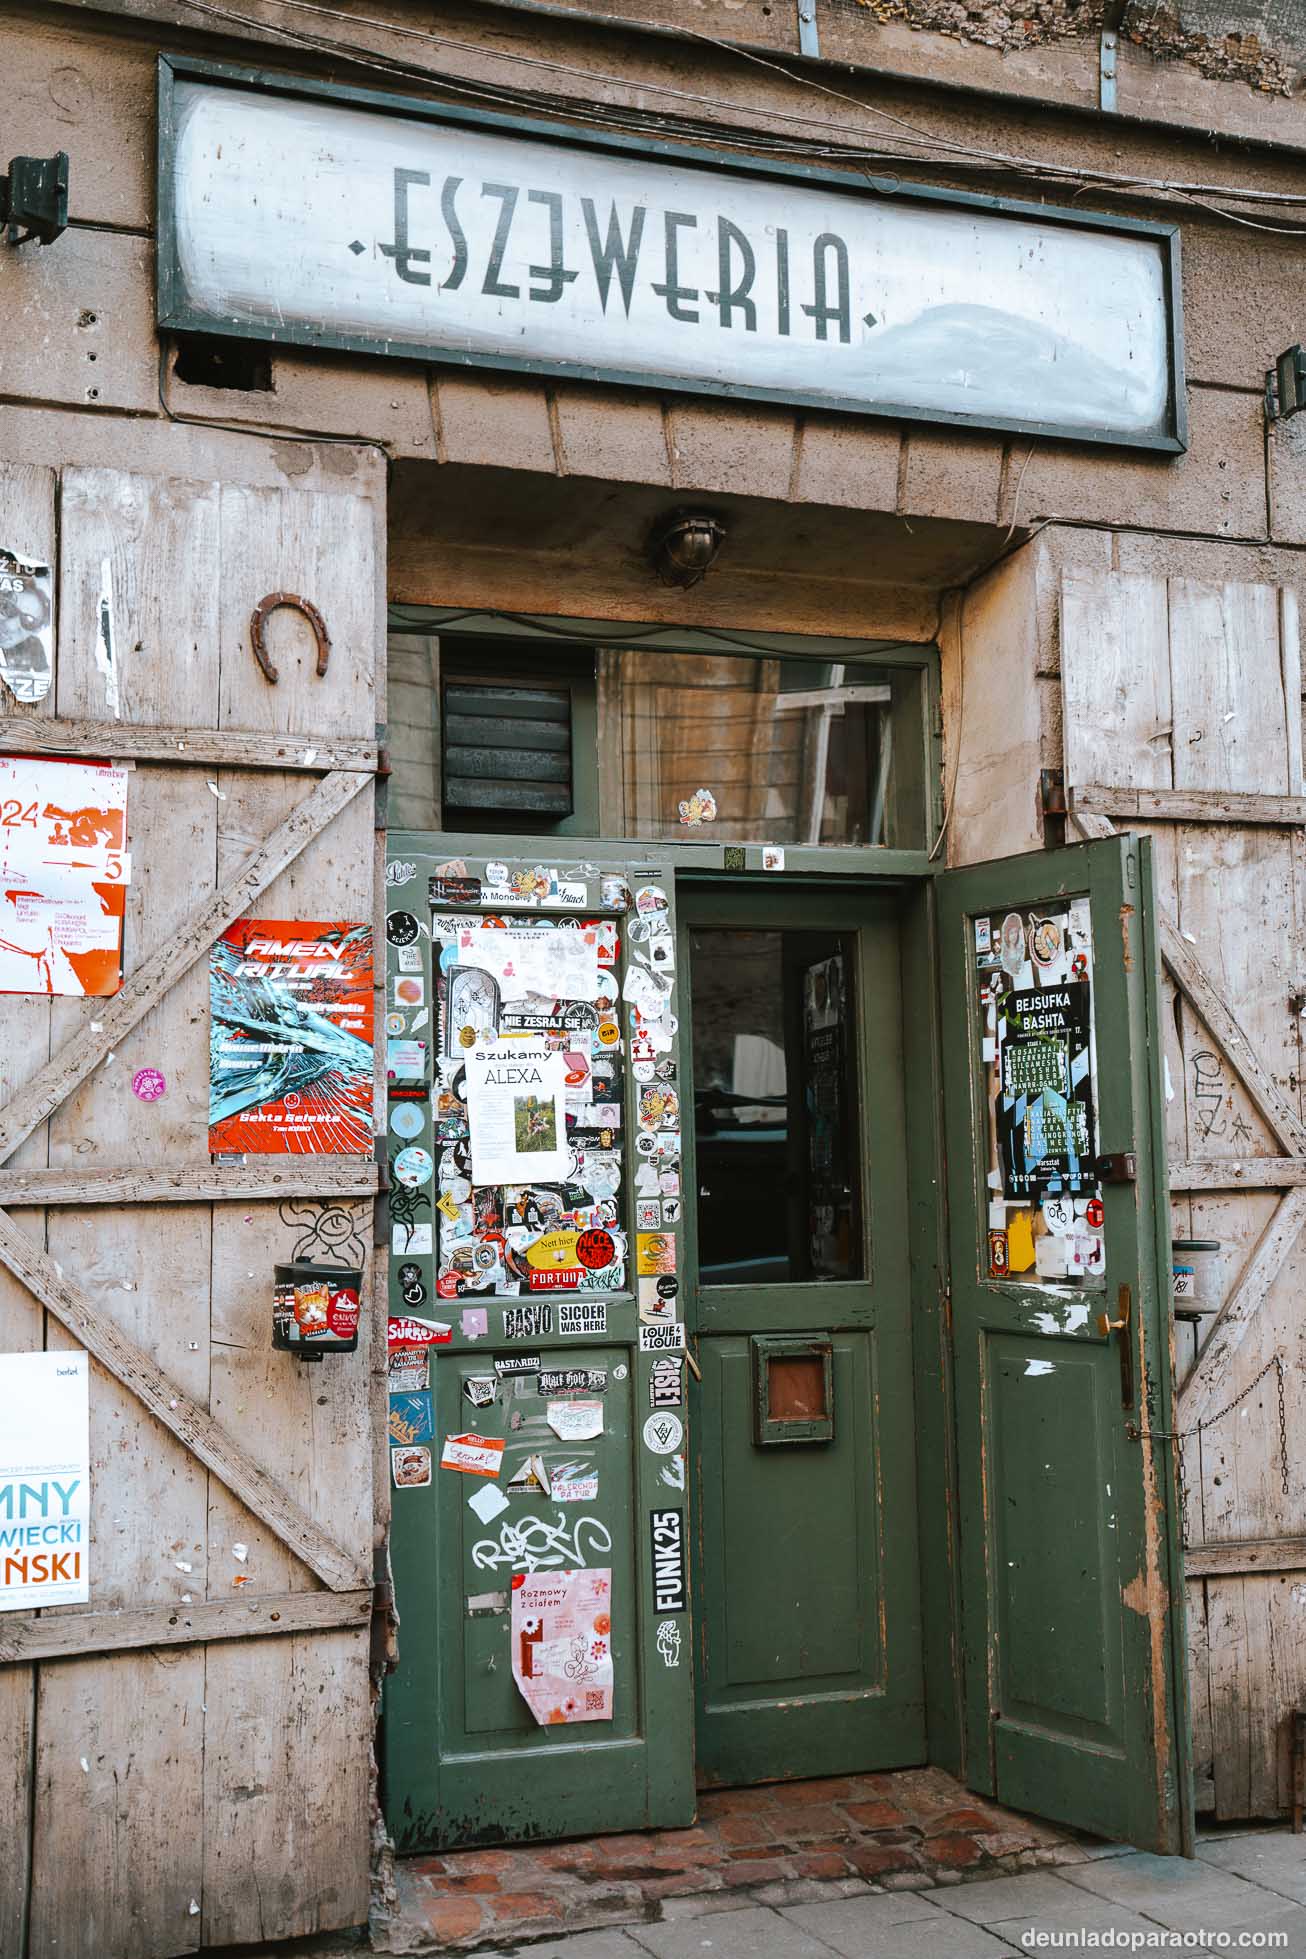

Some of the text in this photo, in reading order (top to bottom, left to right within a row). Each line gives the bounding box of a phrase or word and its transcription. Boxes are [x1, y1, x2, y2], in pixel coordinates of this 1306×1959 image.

[0, 799, 39, 828] 24
[244, 939, 346, 960] AMEN
[234, 962, 353, 979] RITUAL
[1016, 992, 1071, 1012] BEJSUFKA
[504, 1015, 522, 1026] NIE
[524, 1016, 562, 1028] ZESRAJ
[1023, 1012, 1065, 1030] BASHTA
[475, 1050, 552, 1061] Szukamy
[485, 1069, 542, 1085] ALEXA
[240, 1113, 340, 1122] Sekta Selekta
[560, 1305, 605, 1320] SICOER
[561, 1320, 605, 1332] WAS HERE
[643, 1326, 675, 1339] LOUIE
[650, 1336, 681, 1348] LOUIE
[5, 1548, 80, 1585] ŃSKI
[653, 1512, 683, 1610] FUNK25
[520, 1589, 567, 1599] Rozmowy
[528, 1599, 561, 1608] ciałem
